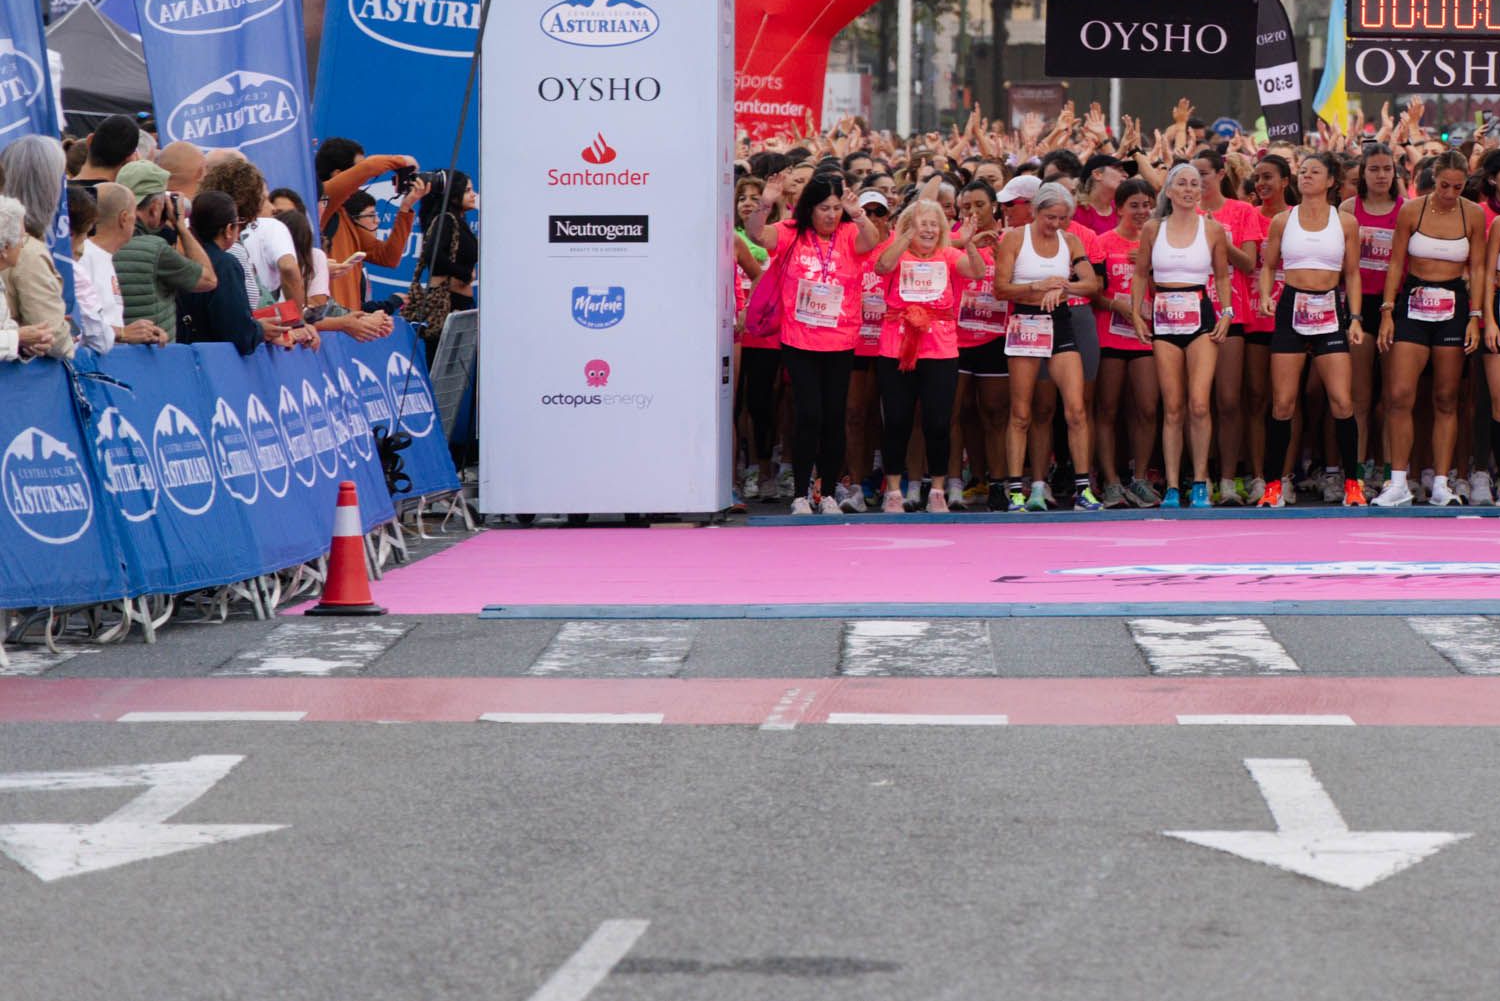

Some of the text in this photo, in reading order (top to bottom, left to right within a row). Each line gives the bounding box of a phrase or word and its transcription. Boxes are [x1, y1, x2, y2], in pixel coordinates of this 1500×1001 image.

[549, 12, 651, 33] ASTURIANA
[1080, 20, 1228, 54] OYSHO
[538, 76, 661, 102] OYSHO
[548, 168, 650, 186] Santander
[556, 221, 644, 240] Neutrogena
[574, 295, 622, 318] Marlene
[810, 300, 827, 310] 016
